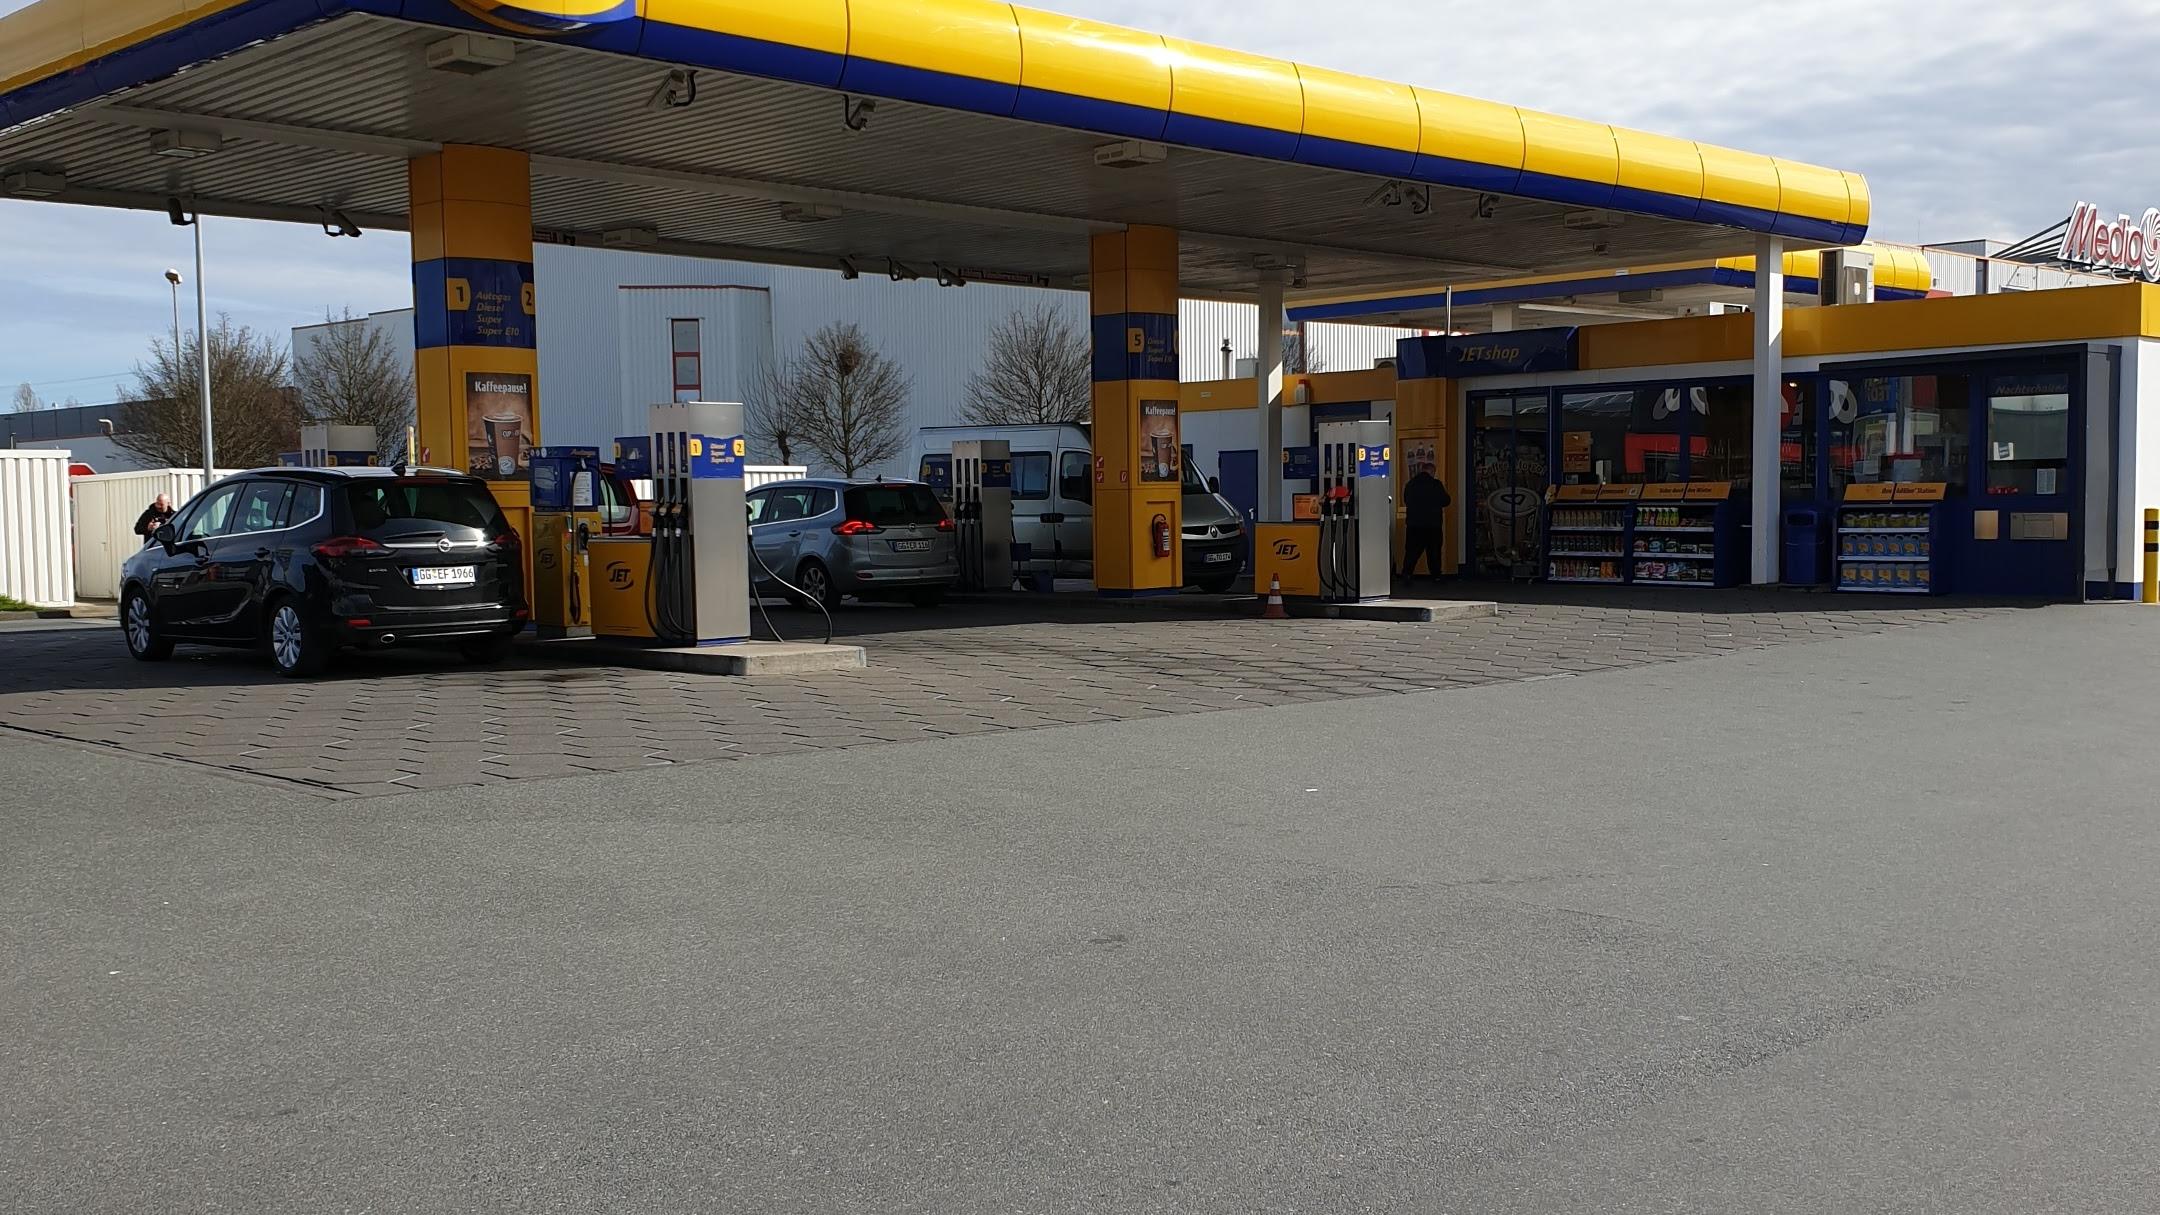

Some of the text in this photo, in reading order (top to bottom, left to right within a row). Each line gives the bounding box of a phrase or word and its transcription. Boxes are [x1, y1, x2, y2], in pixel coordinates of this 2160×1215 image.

[2057, 200, 2144, 272] Media
[456, 286, 463, 302] 1
[476, 291, 511, 303] Autogas
[525, 290, 532, 306] 2
[476, 302, 505, 312] Diesel
[476, 314, 502, 325] Super
[476, 326, 519, 336] Super E10
[1134, 334, 1141, 346] 5
[1459, 344, 1520, 363] JET shop
[475, 380, 527, 394] Kaffeepause!
[693, 443, 698, 454] 1
[736, 443, 743, 453] 2
[1275, 544, 1297, 555] JET
[419, 566, 474, 580] GG EF 1966
[609, 568, 631, 582] JET
